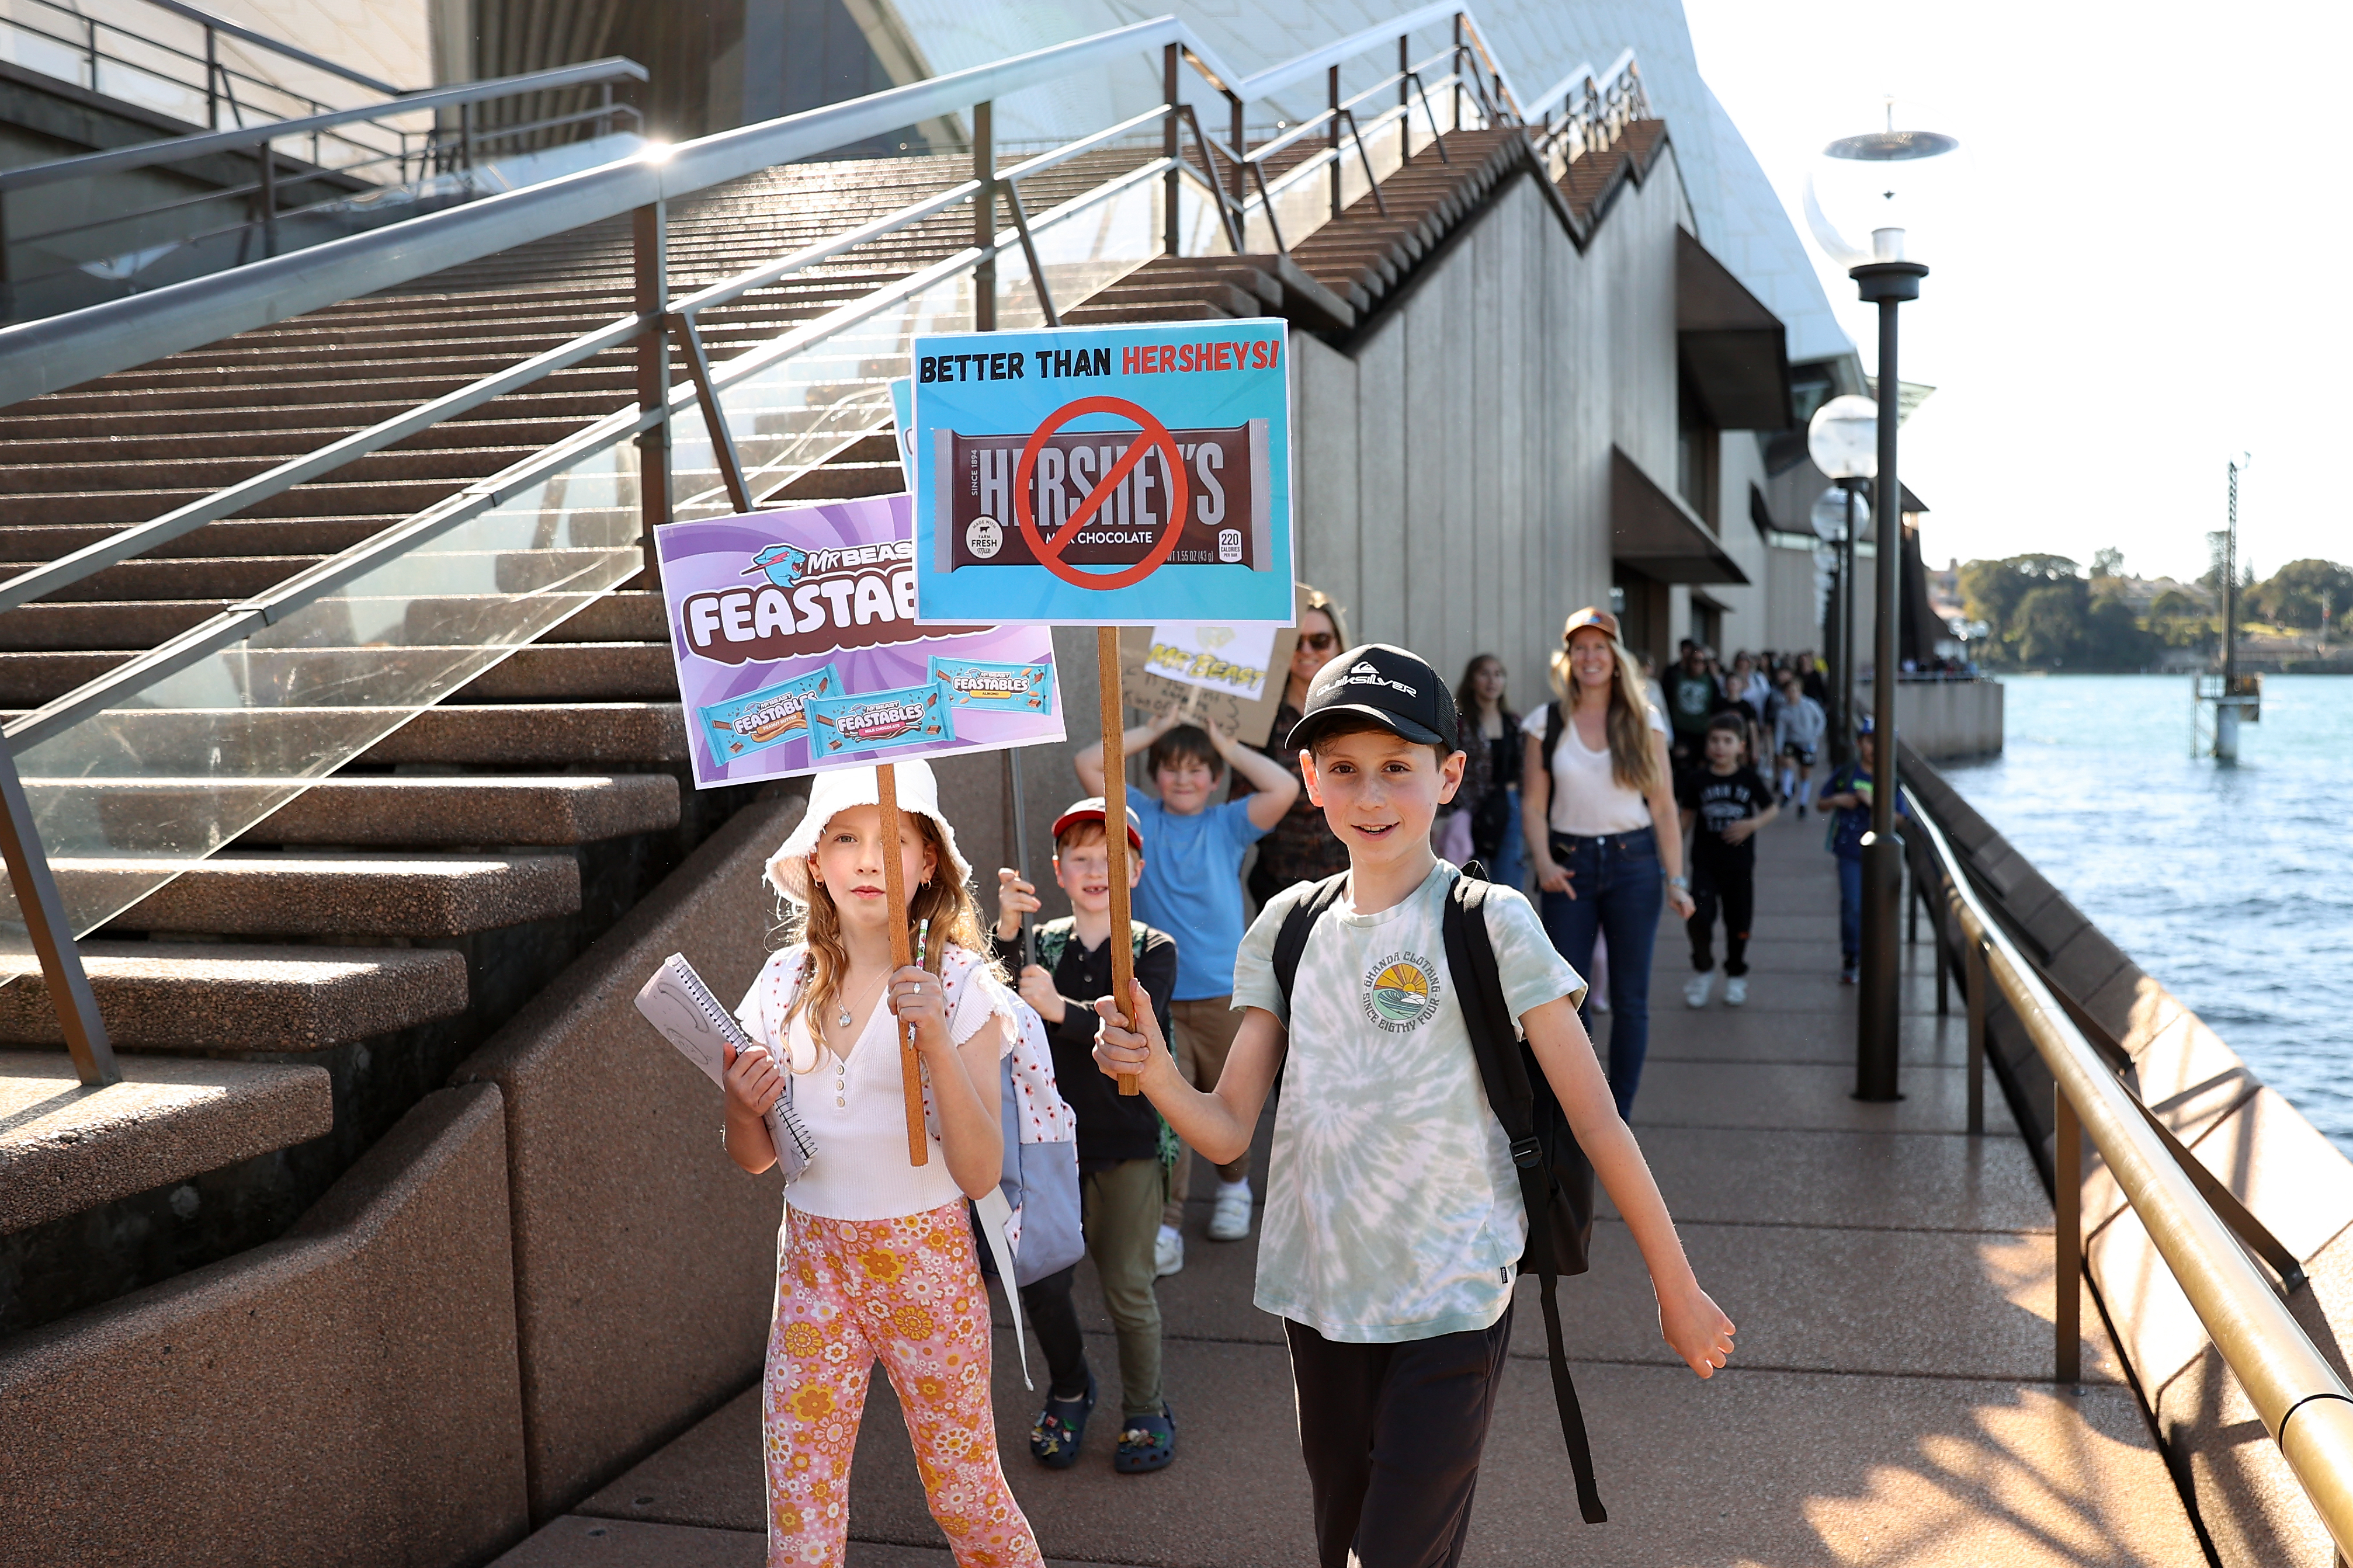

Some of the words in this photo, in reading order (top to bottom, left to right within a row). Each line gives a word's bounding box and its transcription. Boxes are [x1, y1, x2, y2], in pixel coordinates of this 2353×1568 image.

[919, 352, 1025, 383] BETTER
[1035, 347, 1110, 378] THAN
[1122, 340, 1279, 375] HERSHEYS!
[971, 539, 997, 547] FRESH
[1077, 531, 1153, 544] CHOCOLATE
[1221, 533, 1238, 545] 220
[1177, 551, 1188, 561] 1.55
[1189, 551, 1197, 561] OZ
[689, 571, 915, 647] FEASTAB
[953, 677, 1029, 691] FEASTABLES
[1316, 674, 1417, 698] QUIKSILVER
[763, 720, 780, 730] PEANUT
[780, 715, 797, 724] BUTTER
[838, 704, 924, 731] FEASTABLES
[1363, 952, 1400, 988] GHANDA
[1403, 951, 1441, 993] CLOTHING
[1363, 993, 1379, 1023] SINCE
[1378, 1018, 1416, 1033] EIGTHY
[1417, 998, 1440, 1026] FOUR
